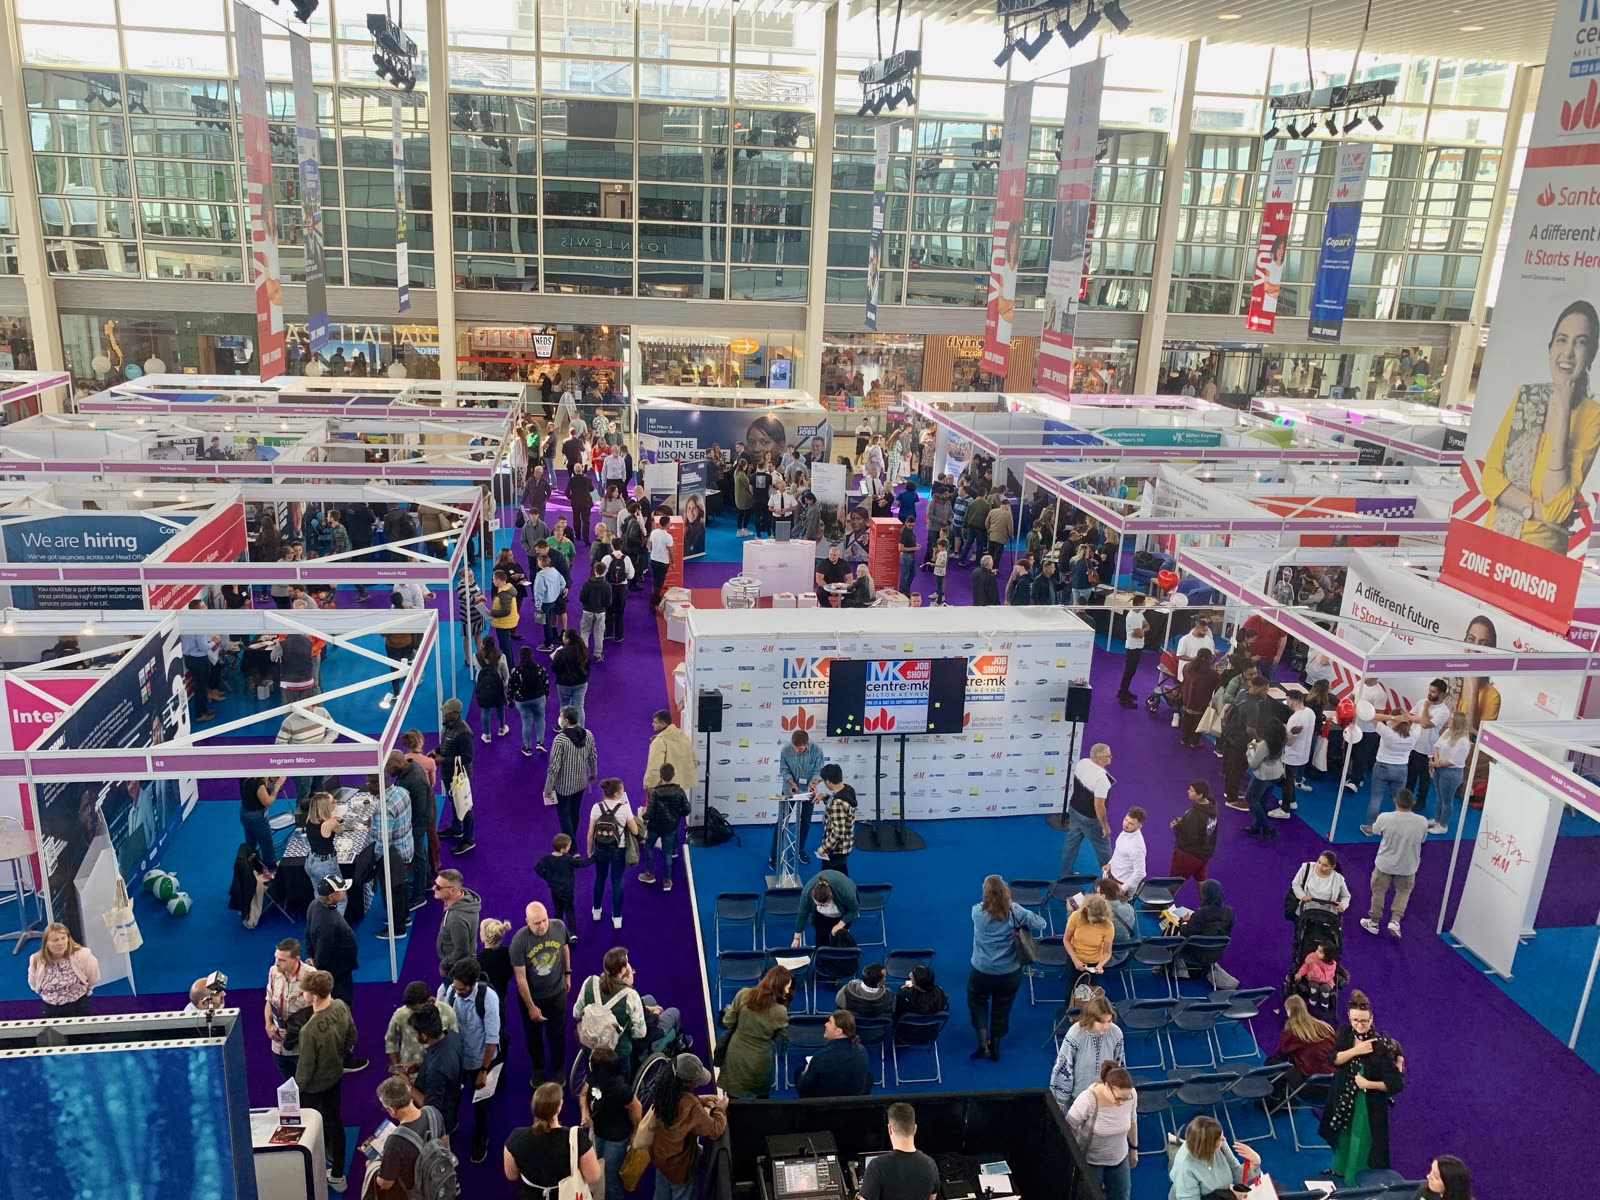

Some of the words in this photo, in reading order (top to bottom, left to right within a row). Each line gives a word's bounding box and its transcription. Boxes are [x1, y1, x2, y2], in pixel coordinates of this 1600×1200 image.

[1529, 224, 1538, 240] A
[1540, 224, 1596, 241] different
[1326, 236, 1352, 248] Copart
[1524, 249, 1533, 264] It
[1534, 249, 1571, 267] Starts
[340, 325, 432, 345] ITALIAN
[658, 440, 678, 449] OIN
[680, 440, 694, 449] THE
[21, 532, 52, 548] We
[54, 537, 79, 548] are
[83, 532, 138, 552] hiring
[1459, 549, 1491, 577] ZONE
[1494, 562, 1558, 603] SPONSOR
[107, 586, 127, 594] largest,
[1351, 602, 1359, 617] It
[1355, 582, 1363, 597] A
[1364, 586, 1407, 617] different
[1407, 605, 1440, 633] future
[991, 656, 1007, 665] JOB
[915, 662, 930, 671] JOB
[982, 665, 1006, 674] SHOW
[906, 671, 929, 679] SHOW
[866, 681, 929, 692] centre:mk
[965, 676, 1006, 687] tre:mk
[269, 758, 294, 766] Ingram
[1551, 774, 1563, 786] H&M
[1563, 782, 1587, 799] Logistics
